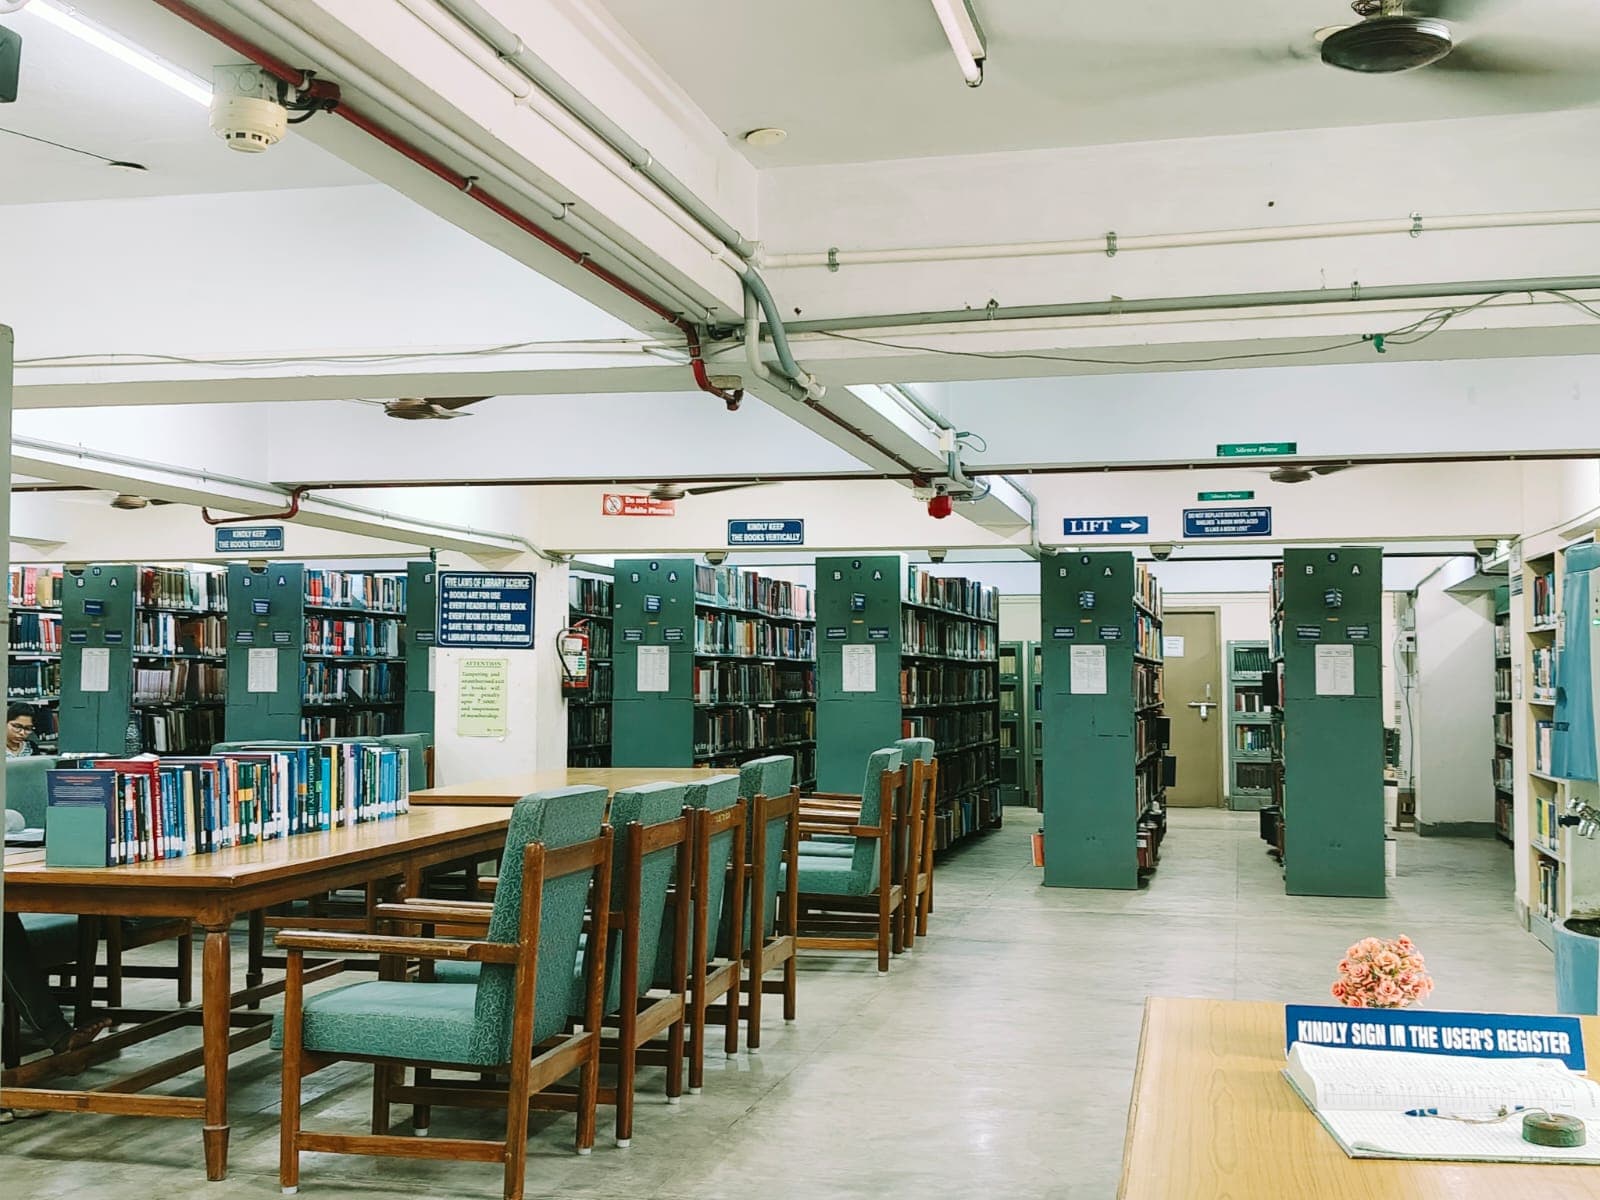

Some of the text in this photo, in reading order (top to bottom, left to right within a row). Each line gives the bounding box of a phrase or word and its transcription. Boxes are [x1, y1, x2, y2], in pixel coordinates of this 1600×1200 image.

[1070, 520, 1112, 533] LIFT
[1306, 566, 1313, 574] B
[1352, 565, 1360, 574] A
[632, 574, 639, 582] B
[874, 571, 881, 579] A
[78, 578, 84, 586] B
[445, 577, 530, 588] FIVE LAWS OF LIBRARY SCIENCE
[1298, 1020, 1571, 1055] KINDLY SIGN IN THE USER'S REGISTER
